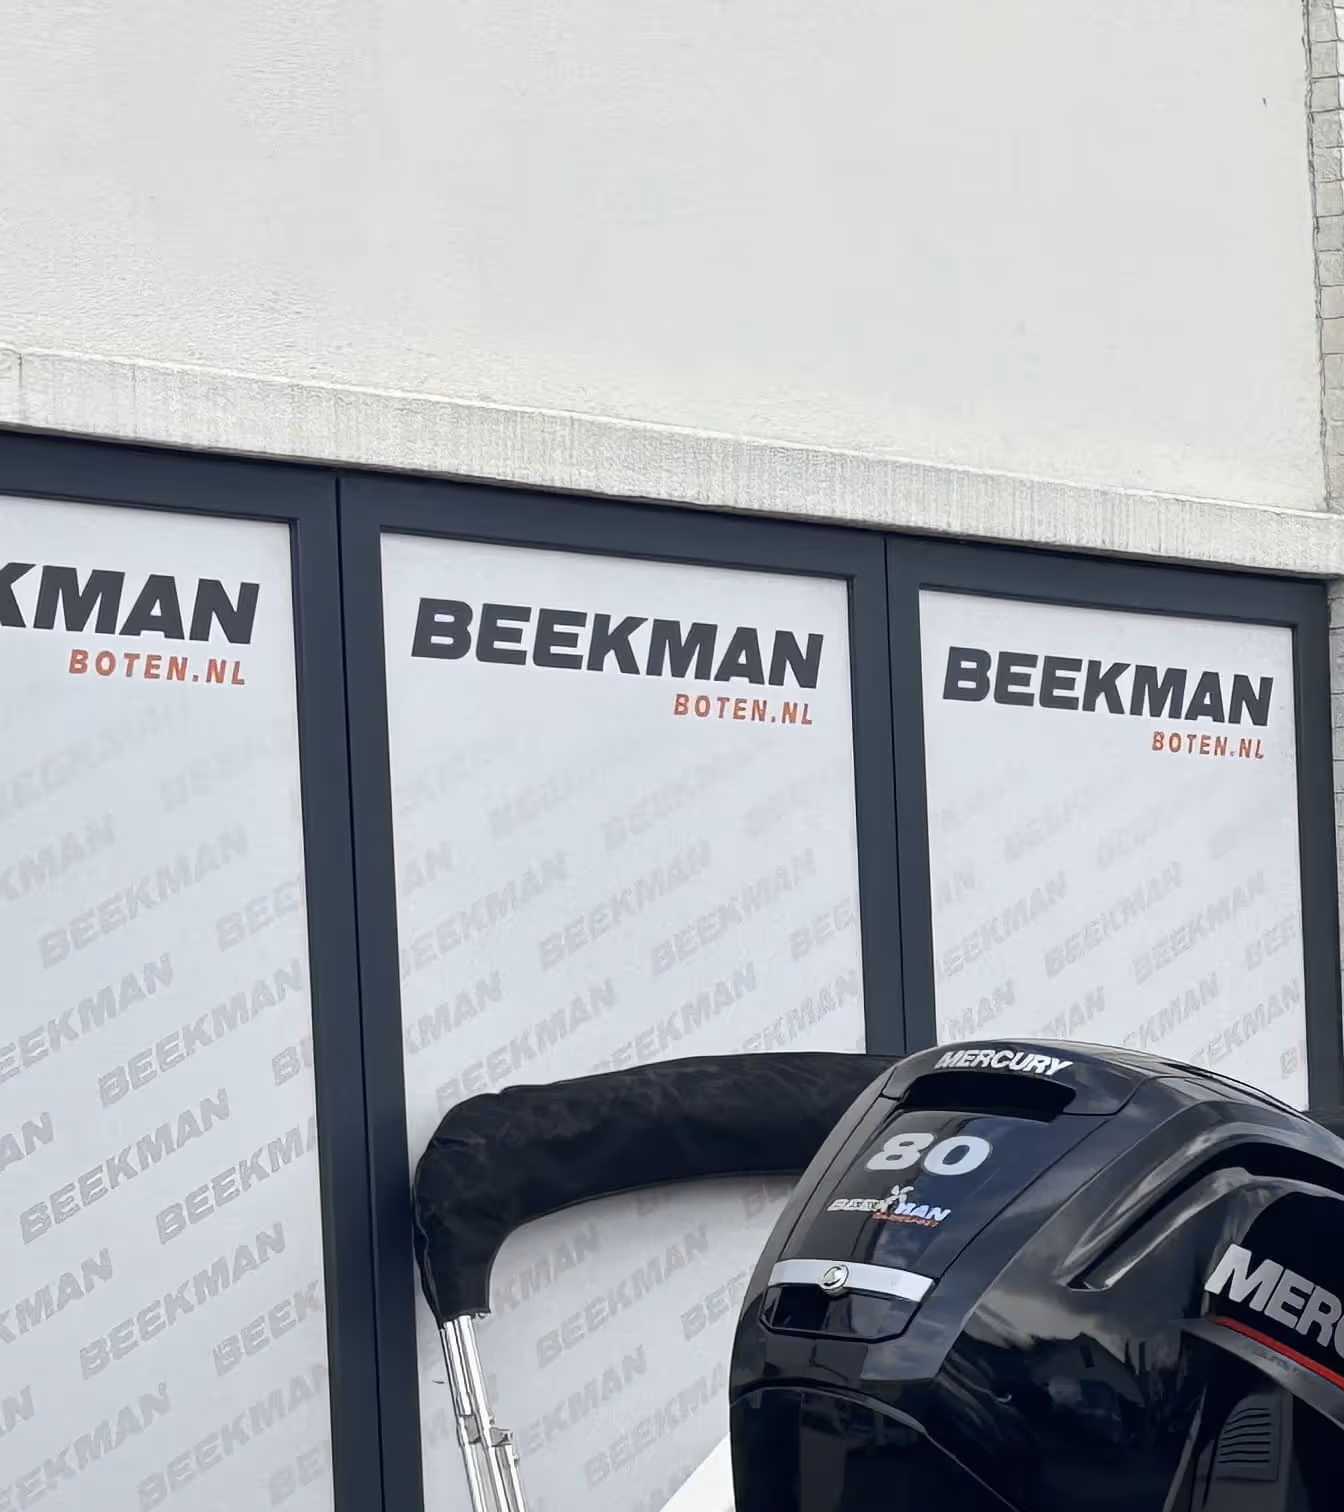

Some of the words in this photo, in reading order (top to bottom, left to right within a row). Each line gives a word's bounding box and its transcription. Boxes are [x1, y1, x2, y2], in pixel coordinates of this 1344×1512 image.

[68, 649, 245, 686] BOTEN.NL
[411, 597, 824, 688] BEEKMAN
[943, 646, 1273, 727] BEEKMAN
[674, 694, 813, 726] BOTEN.NL
[1153, 731, 1264, 759] BOTEN.NL
[38, 822, 249, 970] BEEKMAN
[539, 840, 711, 973] BEEKMAN
[651, 847, 817, 976] BEEKMAN
[937, 870, 1068, 985] EEKMAN
[1044, 861, 1183, 979] BEEKMAN
[1133, 868, 1266, 986] BEEKMAN
[97, 958, 303, 1107] BEEKMAN
[597, 962, 758, 1073] EEKMAN
[934, 1049, 1073, 1076] MERCURY
[19, 1087, 231, 1245] BEEKMAN
[865, 1132, 992, 1176] 80
[79, 1220, 286, 1381] BEEKMAN
[537, 1224, 709, 1369] BEEKMAN
